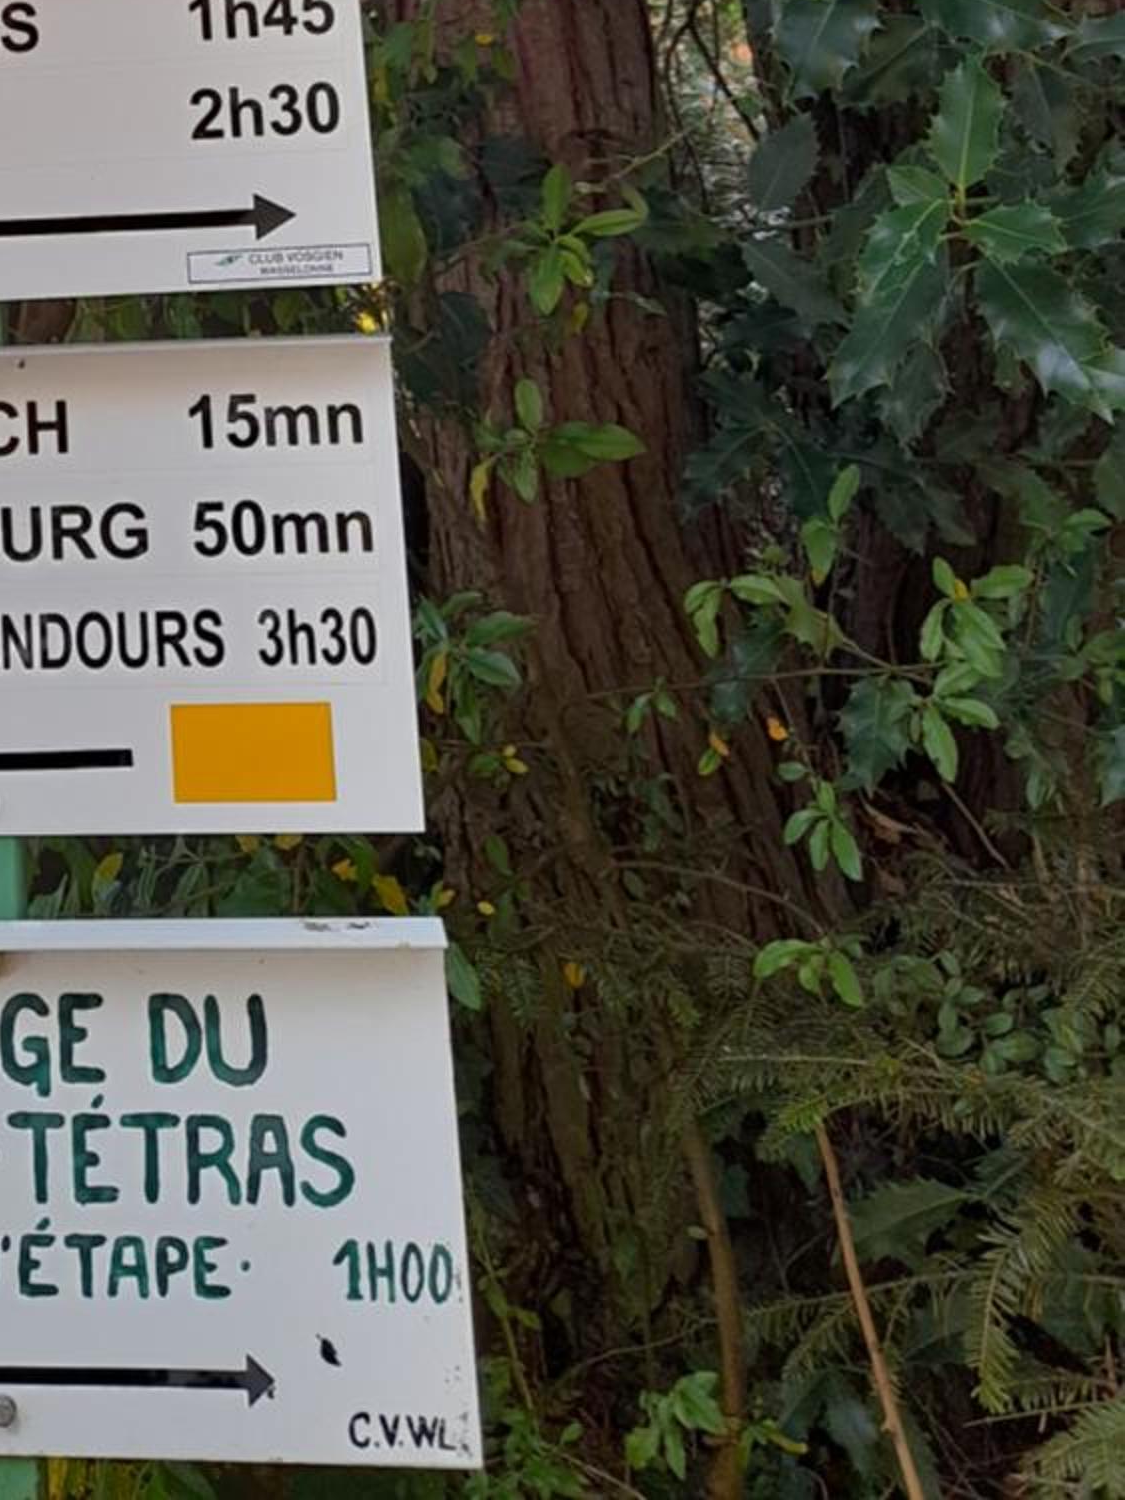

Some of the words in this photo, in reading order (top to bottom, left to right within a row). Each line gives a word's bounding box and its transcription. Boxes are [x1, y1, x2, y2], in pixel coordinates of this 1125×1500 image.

[189, 81, 340, 141] 2h30
[188, 393, 364, 450] 15mn
[194, 499, 374, 558] 50mn
[258, 606, 377, 667] 3h30
[147, 991, 268, 1087] DU
[332, 1238, 454, 1305] 1H00
